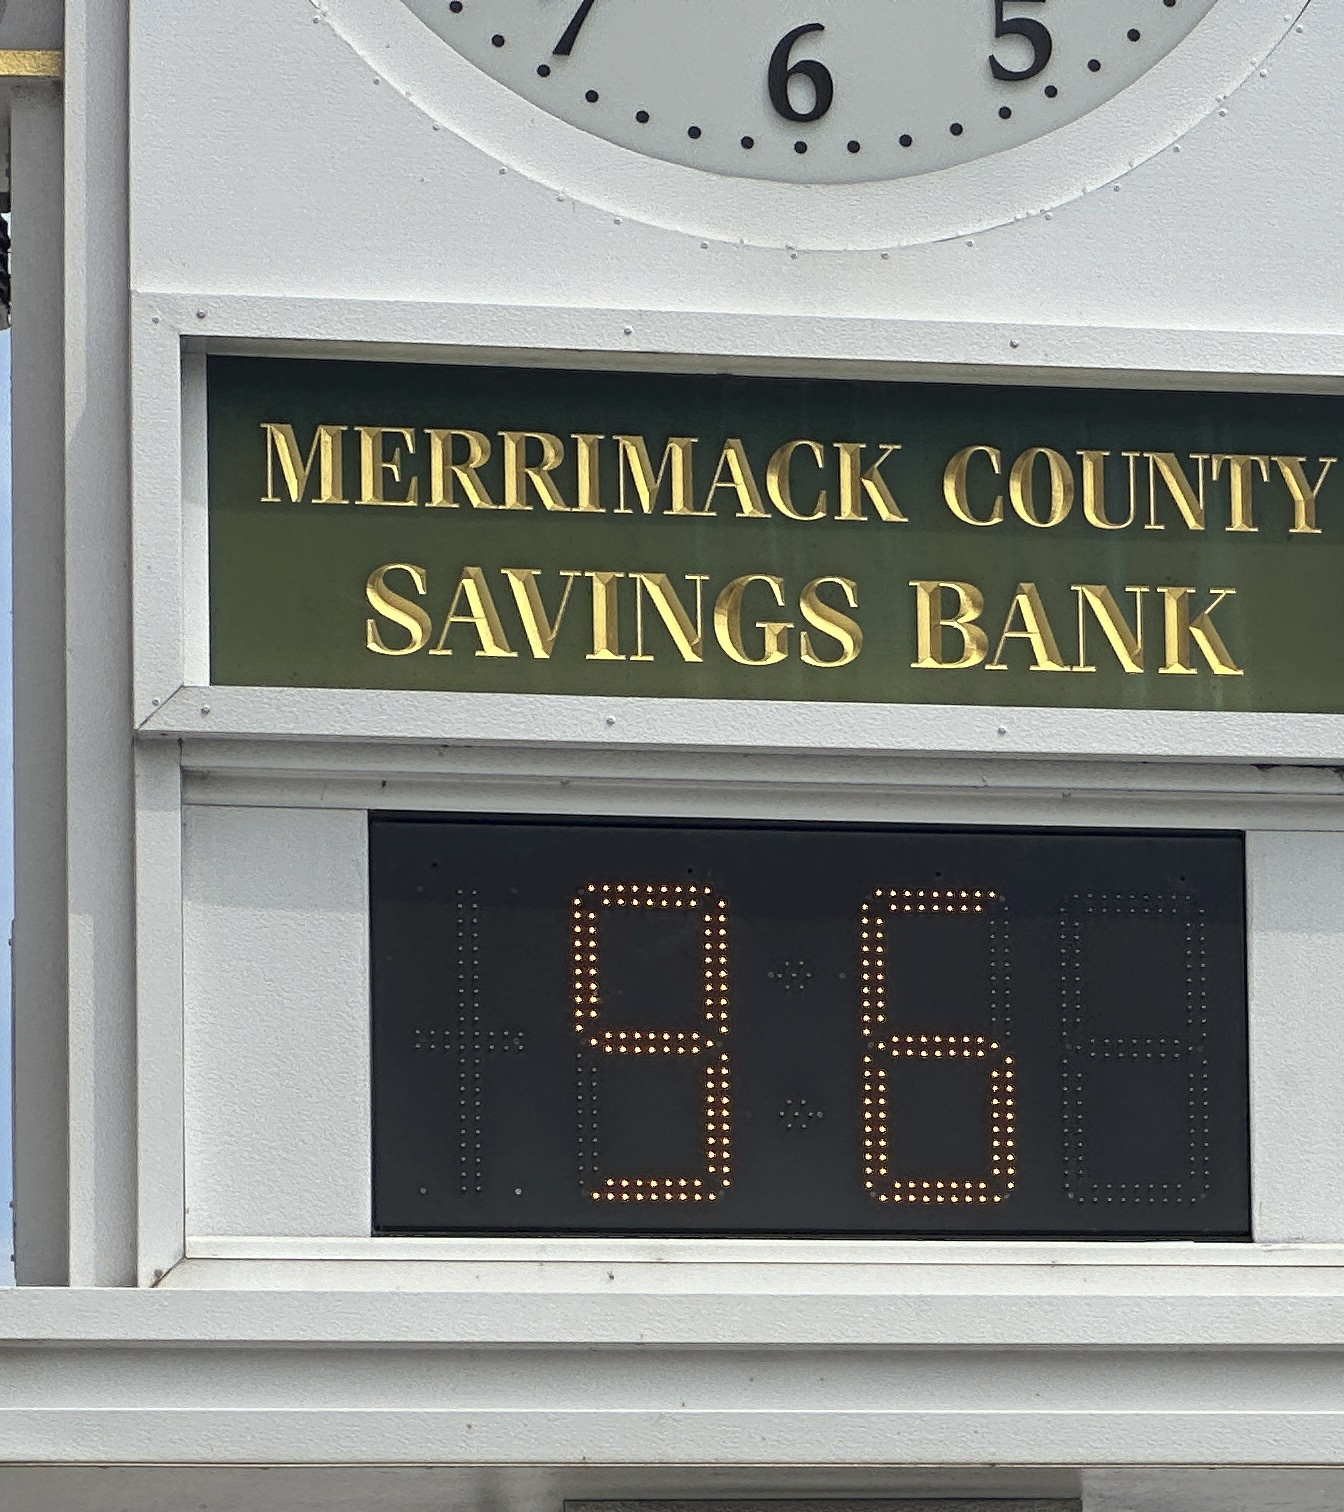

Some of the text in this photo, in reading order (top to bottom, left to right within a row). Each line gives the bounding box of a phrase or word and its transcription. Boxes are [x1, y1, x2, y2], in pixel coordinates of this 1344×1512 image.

[768, 22, 834, 123] 6
[988, 0, 1053, 81] 5
[259, 422, 1338, 534] MERRIMACK COUNTY
[364, 563, 1244, 676] SAVINGS BANK
[571, 884, 1016, 1204] 96
